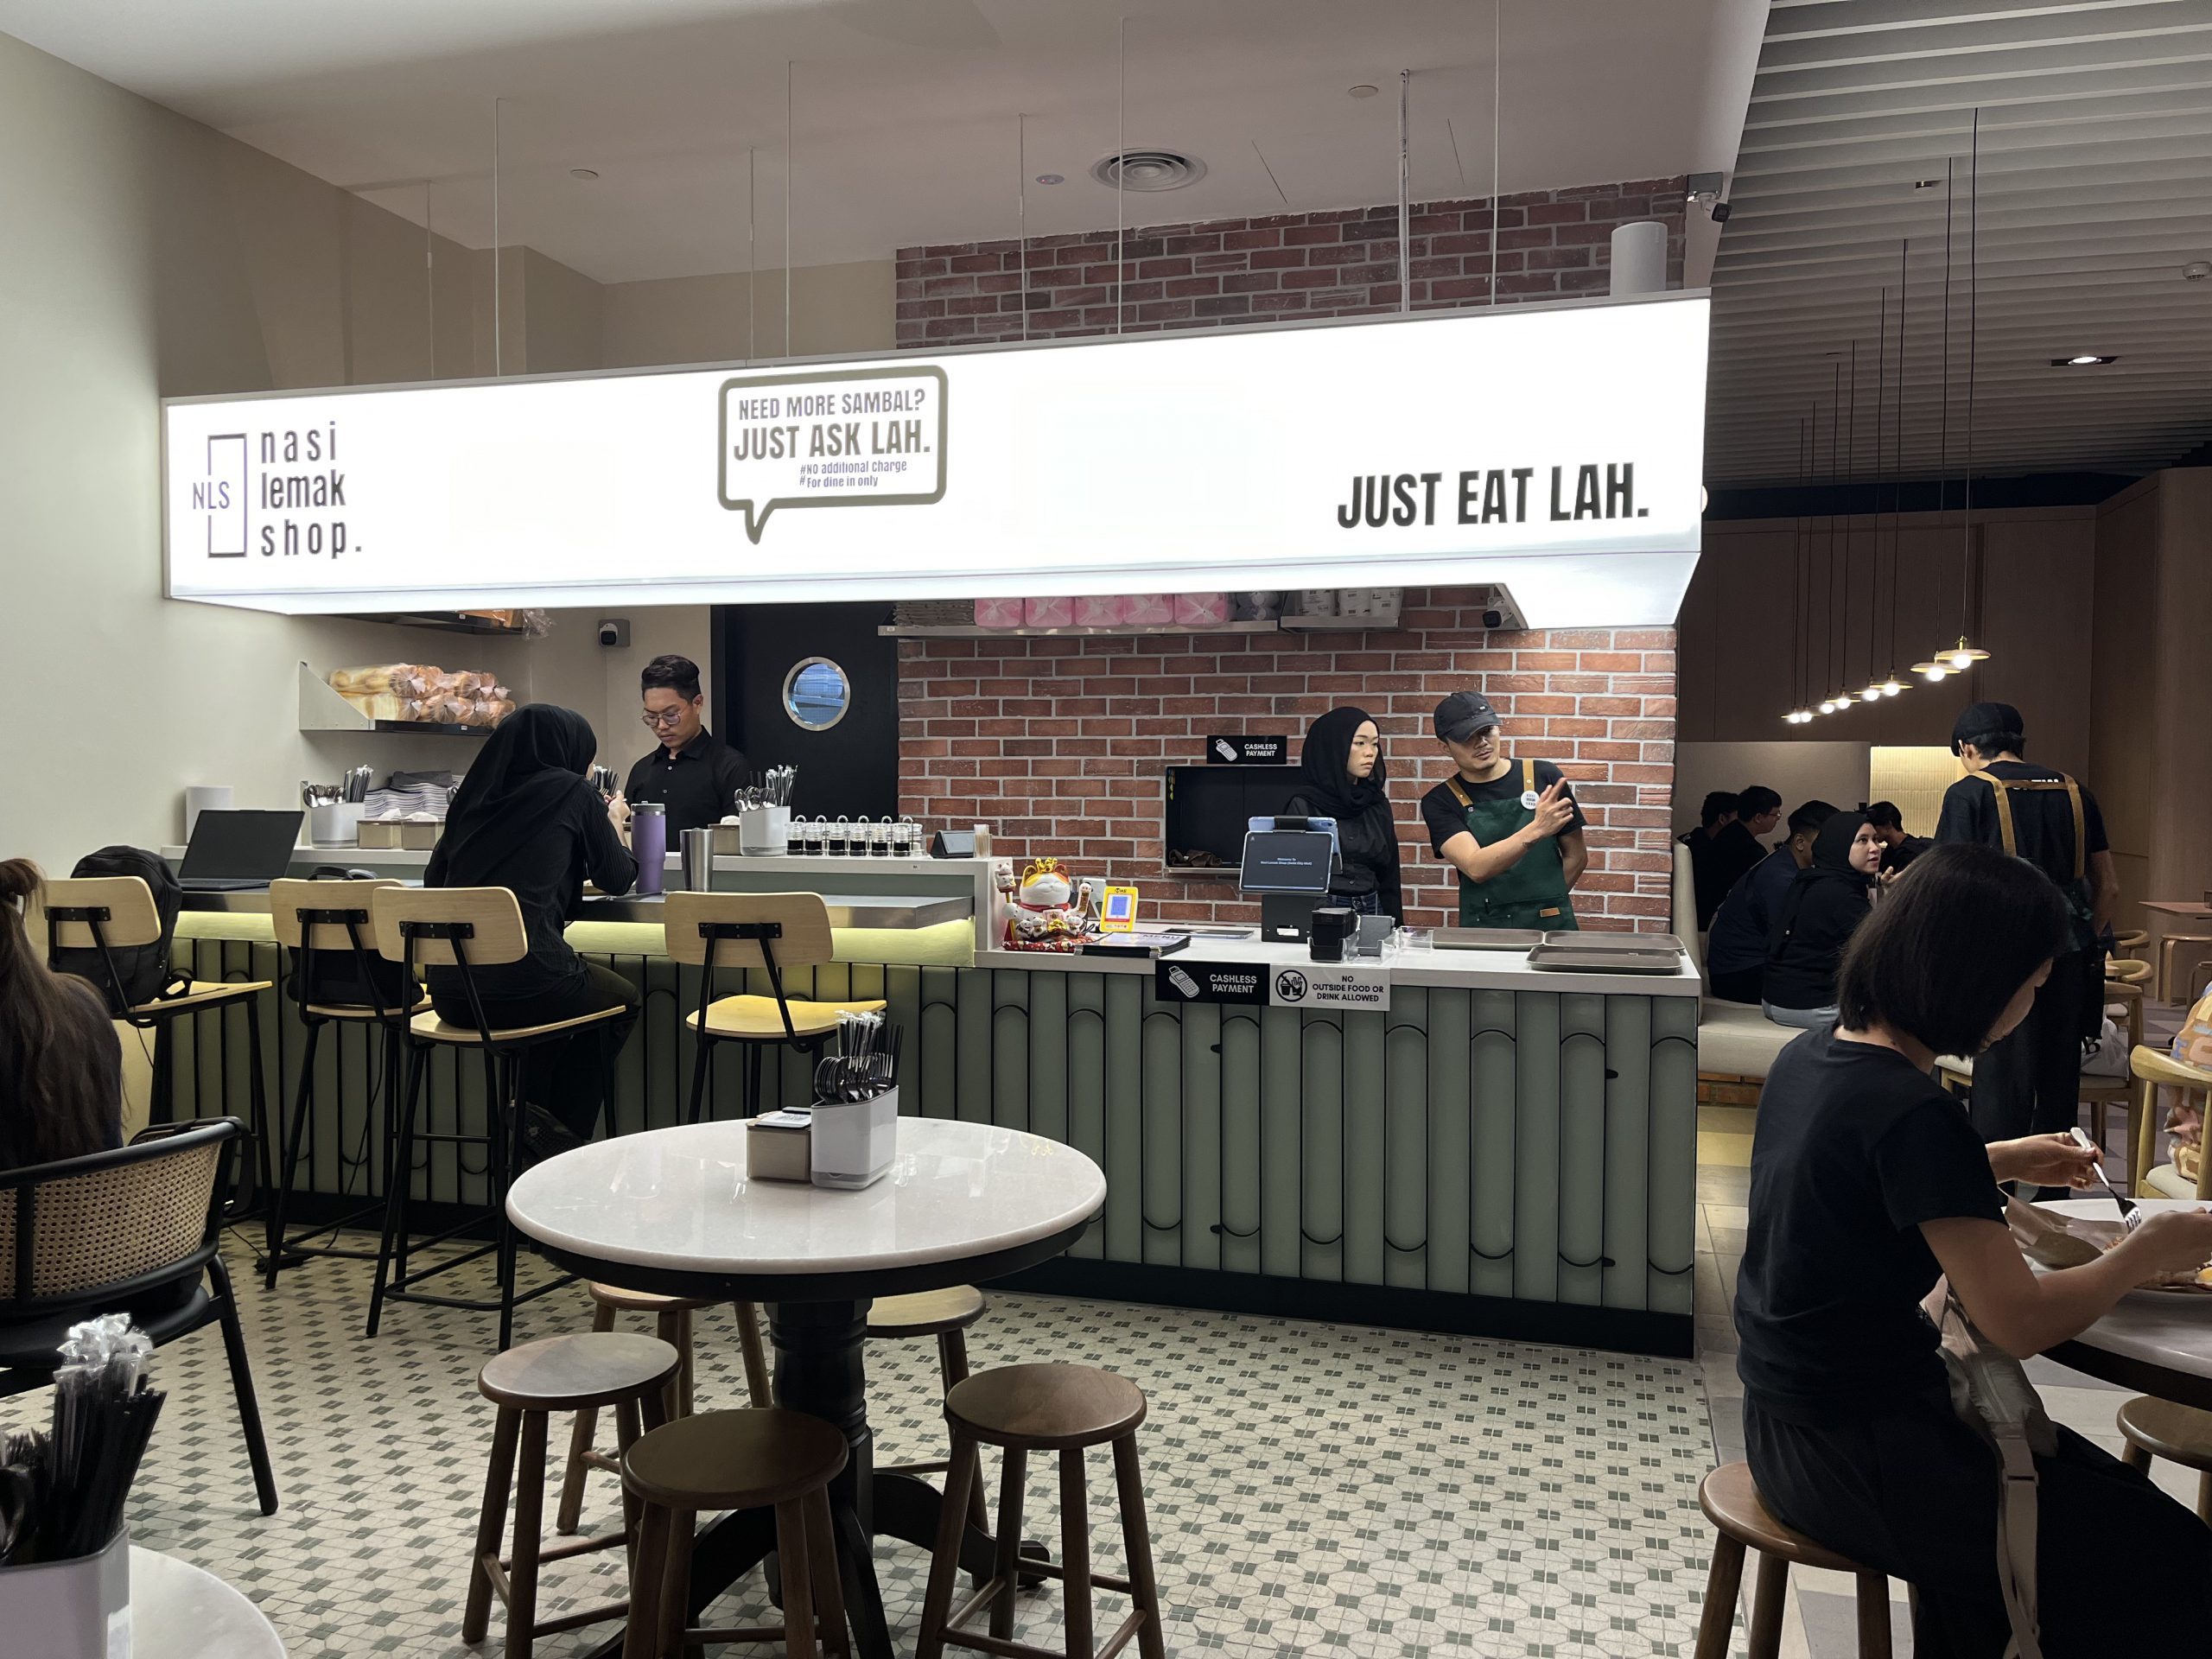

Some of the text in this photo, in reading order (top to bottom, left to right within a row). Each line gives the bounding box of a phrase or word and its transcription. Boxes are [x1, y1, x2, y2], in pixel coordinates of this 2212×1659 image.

[740, 389, 925, 420] NEED MORE SAMBAL?
[261, 421, 335, 463] nasi
[734, 419, 931, 461] JUST ASK LAH.
[821, 461, 868, 474] additional
[872, 460, 907, 473] charge
[823, 477, 844, 487] dine
[847, 476, 855, 486] in
[858, 475, 878, 486] only
[193, 481, 230, 509] NLS
[262, 469, 346, 509] lemak
[1338, 462, 1649, 529] JUST EAT LAH.
[261, 519, 361, 559] shop.
[1210, 974, 1257, 984] CASHLESS
[1212, 983, 1254, 994] PAYMENT
[1341, 993, 1379, 1002] ALLOWED
